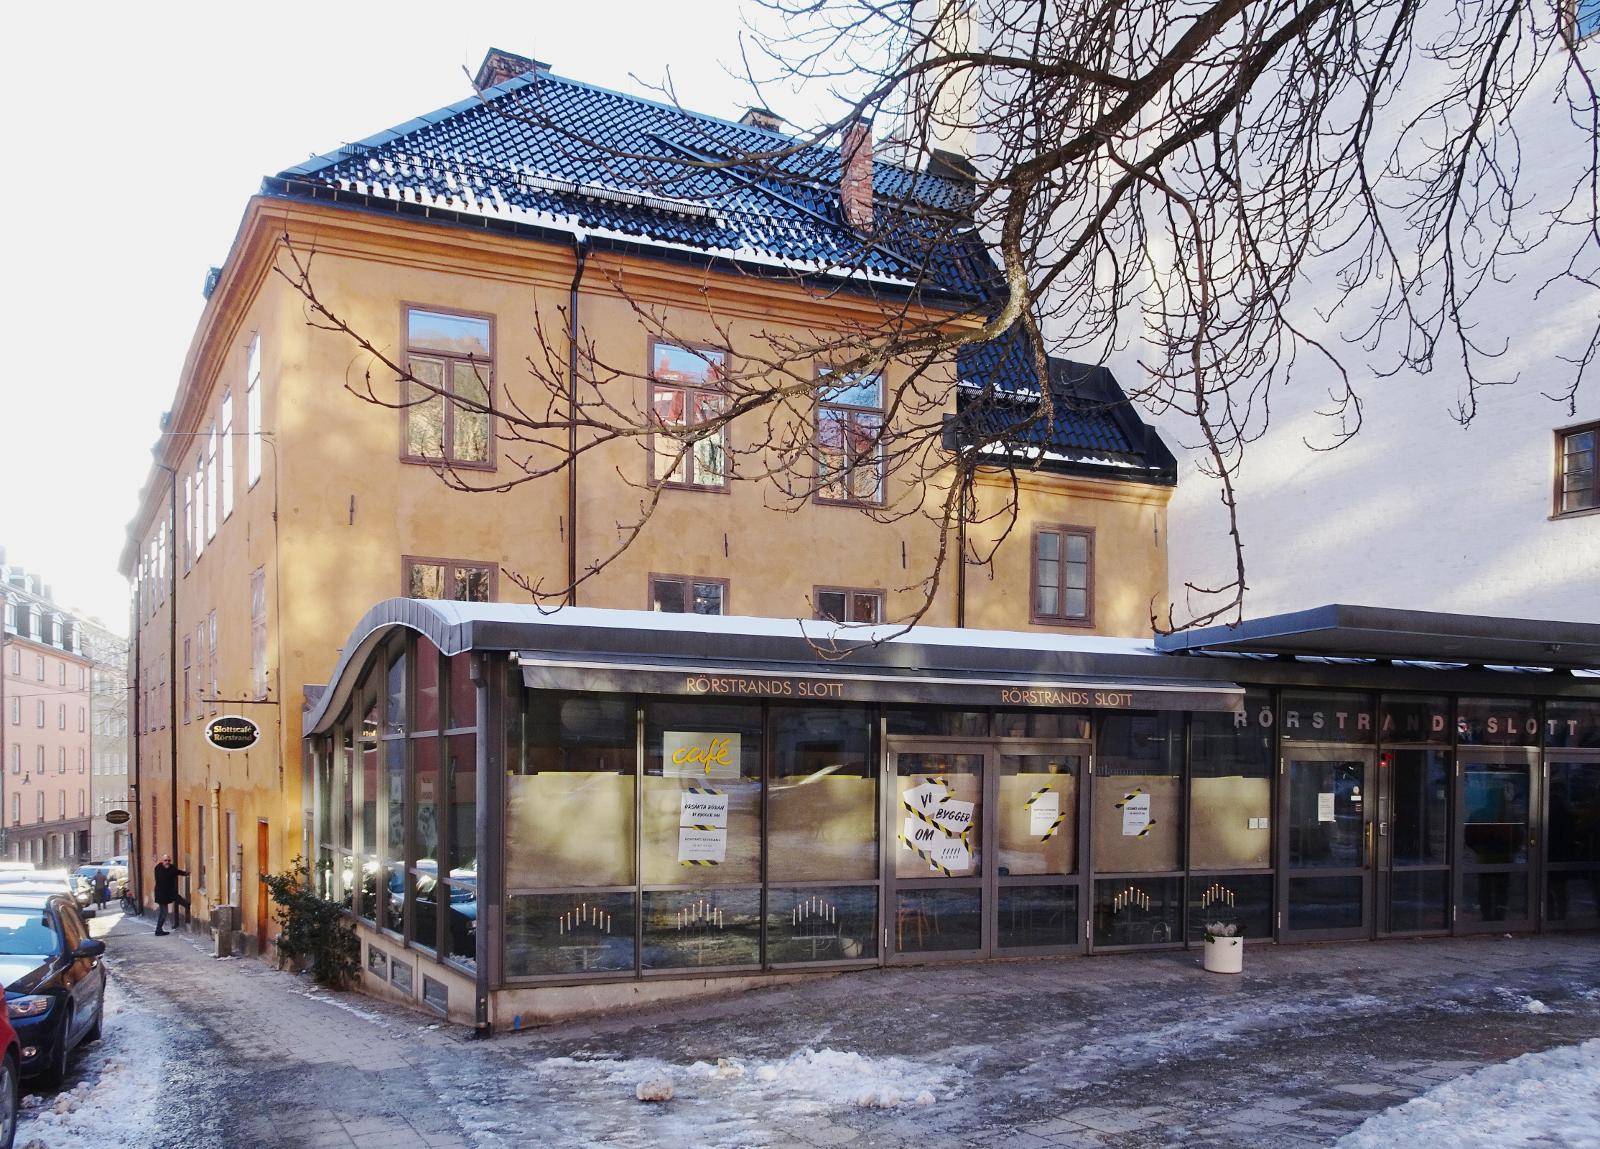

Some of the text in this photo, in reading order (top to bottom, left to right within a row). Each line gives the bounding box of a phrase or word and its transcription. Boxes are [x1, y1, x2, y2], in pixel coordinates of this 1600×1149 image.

[686, 675, 844, 697] RÖRSTRANDS SLOTT
[1001, 688, 1133, 706] RÖRSTRANDS SLOTT
[213, 725, 252, 733] Slottscafé
[1487, 716, 1578, 736] SLOTT
[672, 736, 734, 776] café
[935, 808, 971, 823] BYGGER
[914, 828, 935, 841] OM
